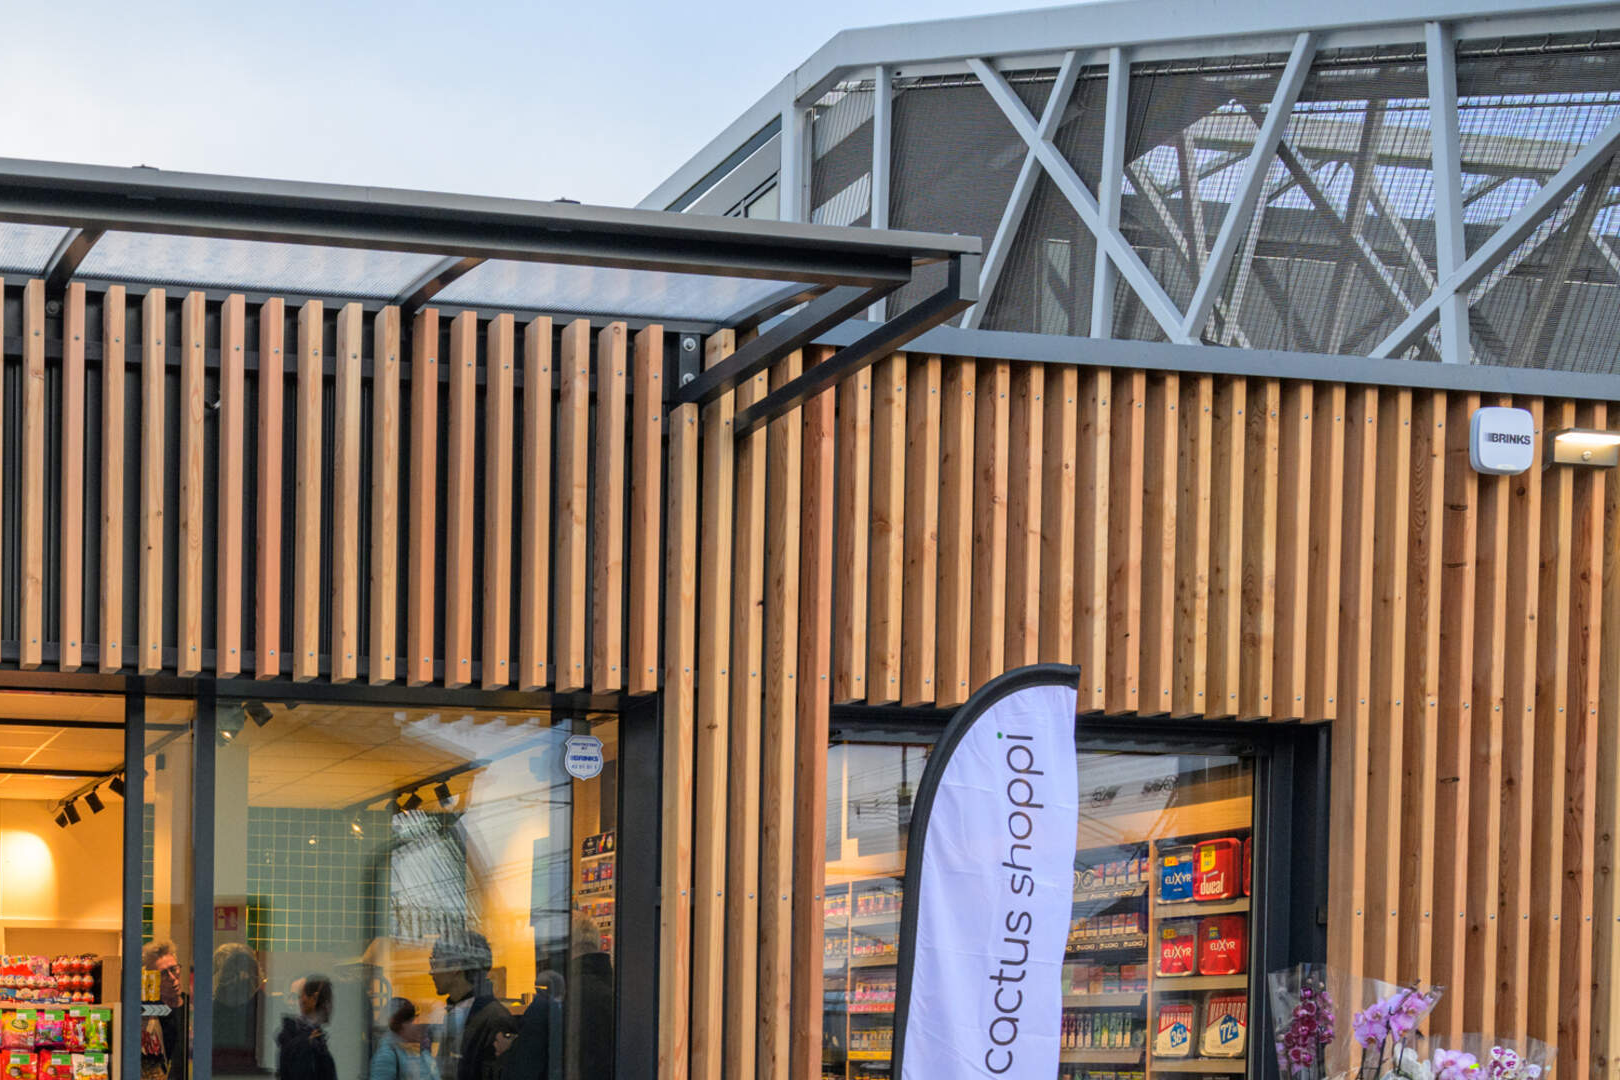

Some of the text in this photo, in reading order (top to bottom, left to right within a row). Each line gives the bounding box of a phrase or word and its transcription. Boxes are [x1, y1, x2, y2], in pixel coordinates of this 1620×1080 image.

[1491, 432, 1531, 445] BRINKS
[997, 731, 1045, 896] shoppi
[1164, 872, 1192, 885] ELIXYR
[1200, 872, 1225, 895] ducal
[1163, 945, 1192, 959] ELIXYR
[1210, 939, 1236, 951] ELIXYR
[985, 910, 1032, 1075] cactus
